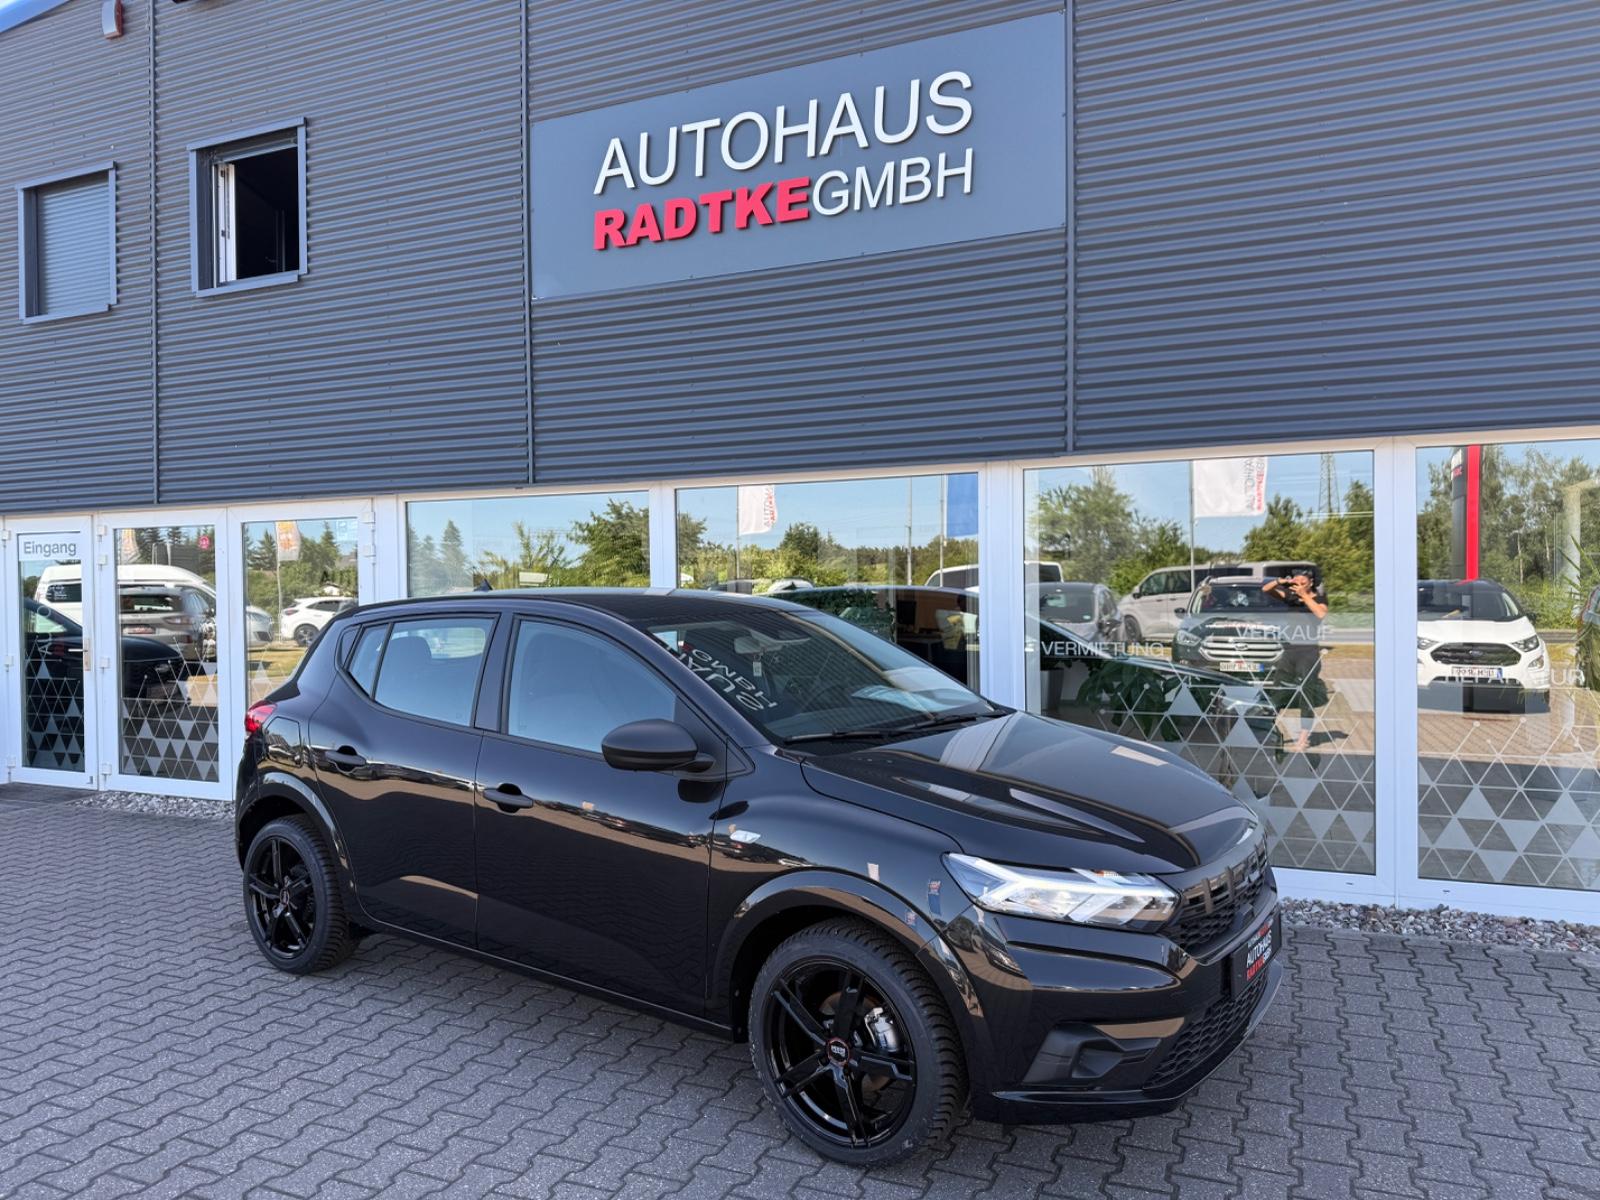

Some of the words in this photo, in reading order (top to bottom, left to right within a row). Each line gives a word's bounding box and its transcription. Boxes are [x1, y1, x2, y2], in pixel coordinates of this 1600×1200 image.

[593, 70, 973, 195] AUTOHAUS
[593, 177, 810, 250] RADTKE
[812, 148, 973, 216] GMBH
[23, 541, 77, 557] Eingang
[1235, 625, 1333, 641] VERKAUF
[1040, 641, 1164, 656] VERMIETUNG
